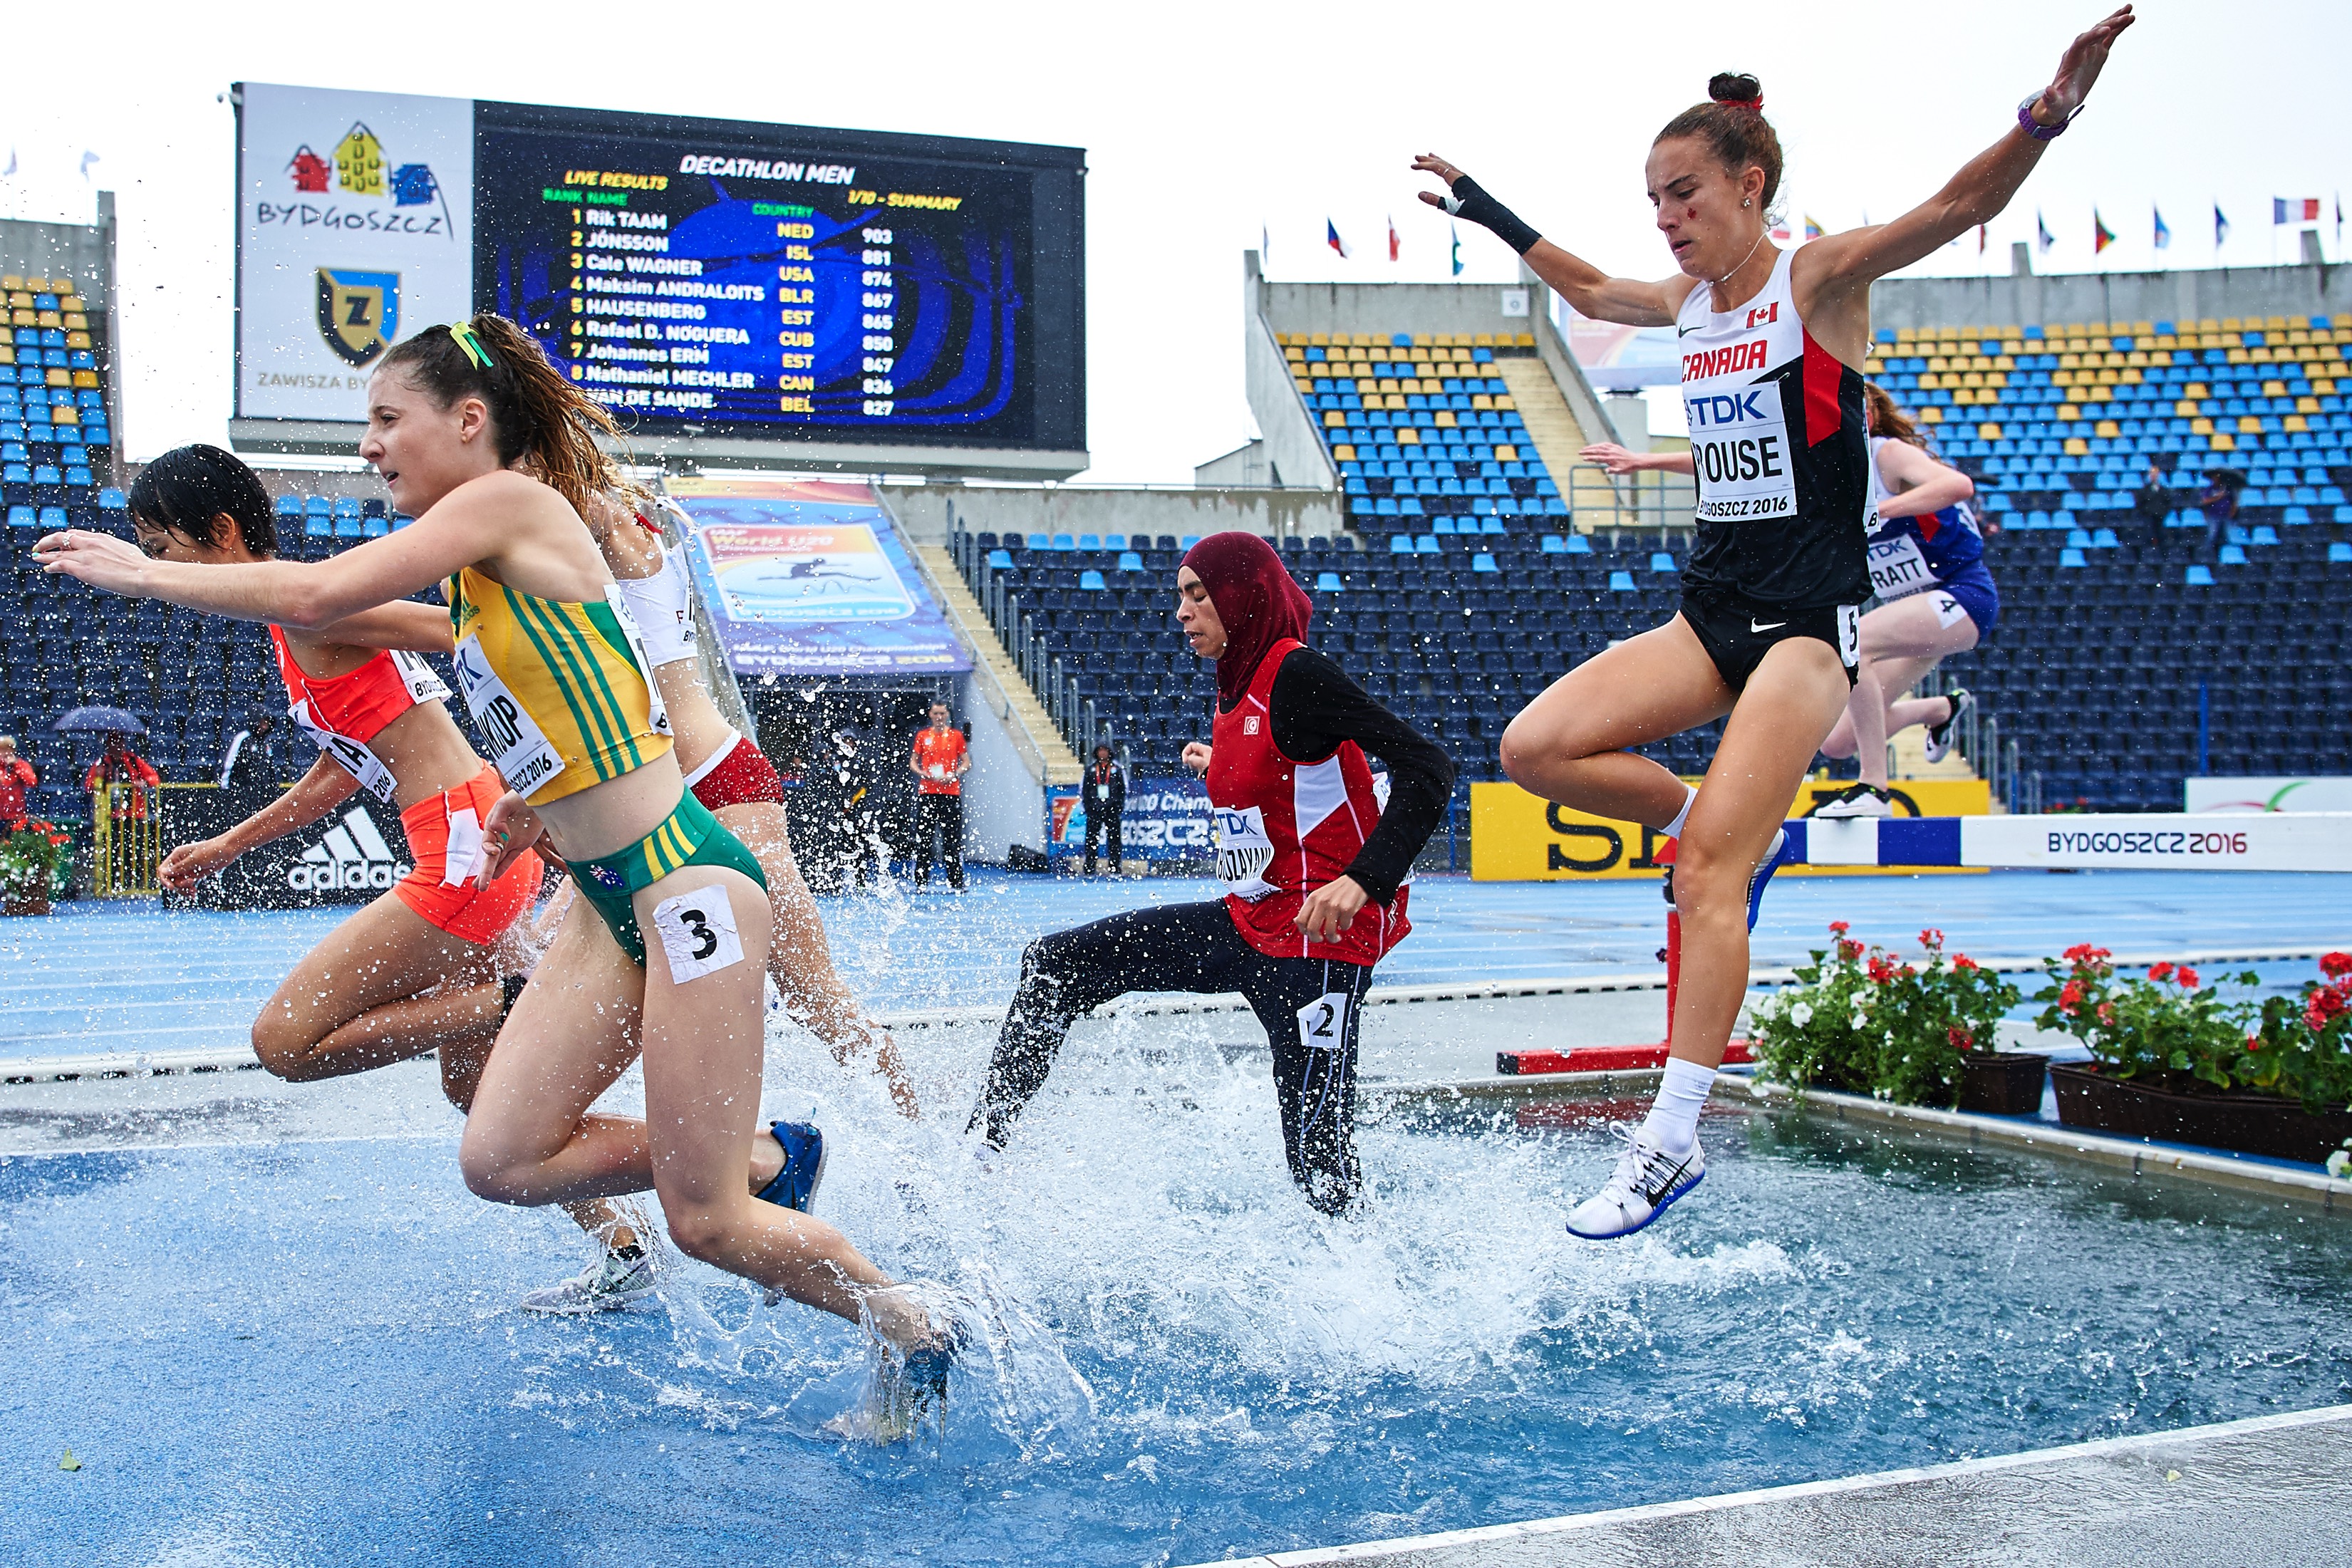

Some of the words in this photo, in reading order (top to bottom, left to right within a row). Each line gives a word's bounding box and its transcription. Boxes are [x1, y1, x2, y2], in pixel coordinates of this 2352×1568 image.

[564, 170, 600, 186] LIVE
[600, 172, 669, 191] RESULTS
[679, 155, 805, 182] DECATHLON
[805, 164, 856, 185] MEN
[542, 187, 584, 203] RANK
[586, 190, 628, 207] NAME
[752, 202, 814, 218] COUNTRY
[847, 189, 877, 205] 1/10
[886, 192, 963, 212] SUMMARY
[257, 202, 442, 236] BYDGOSZCZ
[571, 208, 581, 225] 1
[586, 209, 616, 227] Rik
[617, 211, 668, 230] TAAM
[777, 222, 814, 239] NED
[861, 227, 893, 245] 903
[571, 230, 584, 248] 2
[586, 228, 670, 252] JÓNSSON
[786, 245, 814, 261] ISL
[861, 249, 891, 266] 881
[570, 252, 584, 269] 3
[585, 254, 624, 272] Cale
[626, 255, 703, 276] WAGNER
[779, 266, 814, 283] USA
[861, 271, 893, 288] 874
[570, 275, 584, 291] 4
[586, 276, 654, 294] Maksim
[655, 280, 766, 302] ANDRALOITS
[779, 288, 814, 304] BLR
[861, 292, 893, 308] 867
[346, 296, 371, 326] Z
[570, 297, 584, 314] 5
[586, 298, 707, 320] HAUSENBERG
[782, 309, 814, 326] EST
[862, 313, 893, 331] 865
[571, 320, 584, 336] 6
[586, 321, 643, 338] Rafael
[643, 323, 663, 341] D.
[665, 324, 750, 345] NOGUERA
[779, 331, 814, 347] CUB
[862, 336, 893, 352] 850
[571, 341, 584, 358] 7
[585, 343, 668, 363] Johannes
[670, 347, 710, 365] ERM
[782, 353, 814, 369] EST
[862, 356, 894, 373] 847
[1682, 340, 1768, 383] CANADA
[258, 373, 342, 389] ZAWISZA
[571, 364, 584, 381] 8
[586, 365, 670, 385] Nathaniel
[672, 370, 755, 389] MECHLER
[779, 374, 814, 391] CAN
[862, 378, 893, 395] 836
[626, 389, 651, 406] DE
[653, 390, 714, 409] SANDE
[780, 396, 815, 413] BEL
[862, 400, 894, 416] 827
[1690, 390, 1768, 427] TDK
[1752, 495, 1788, 514] 2016
[711, 536, 783, 546] World
[735, 654, 893, 667] BYDGOSZCZ
[527, 752, 553, 782] 2016
[1216, 813, 1258, 836] TDK
[2048, 833, 2186, 853] BYDGOSZCZ
[2189, 832, 2248, 853] 2016
[288, 858, 412, 890] adidas
[680, 910, 717, 960] 3
[1312, 1003, 1334, 1037] 2
